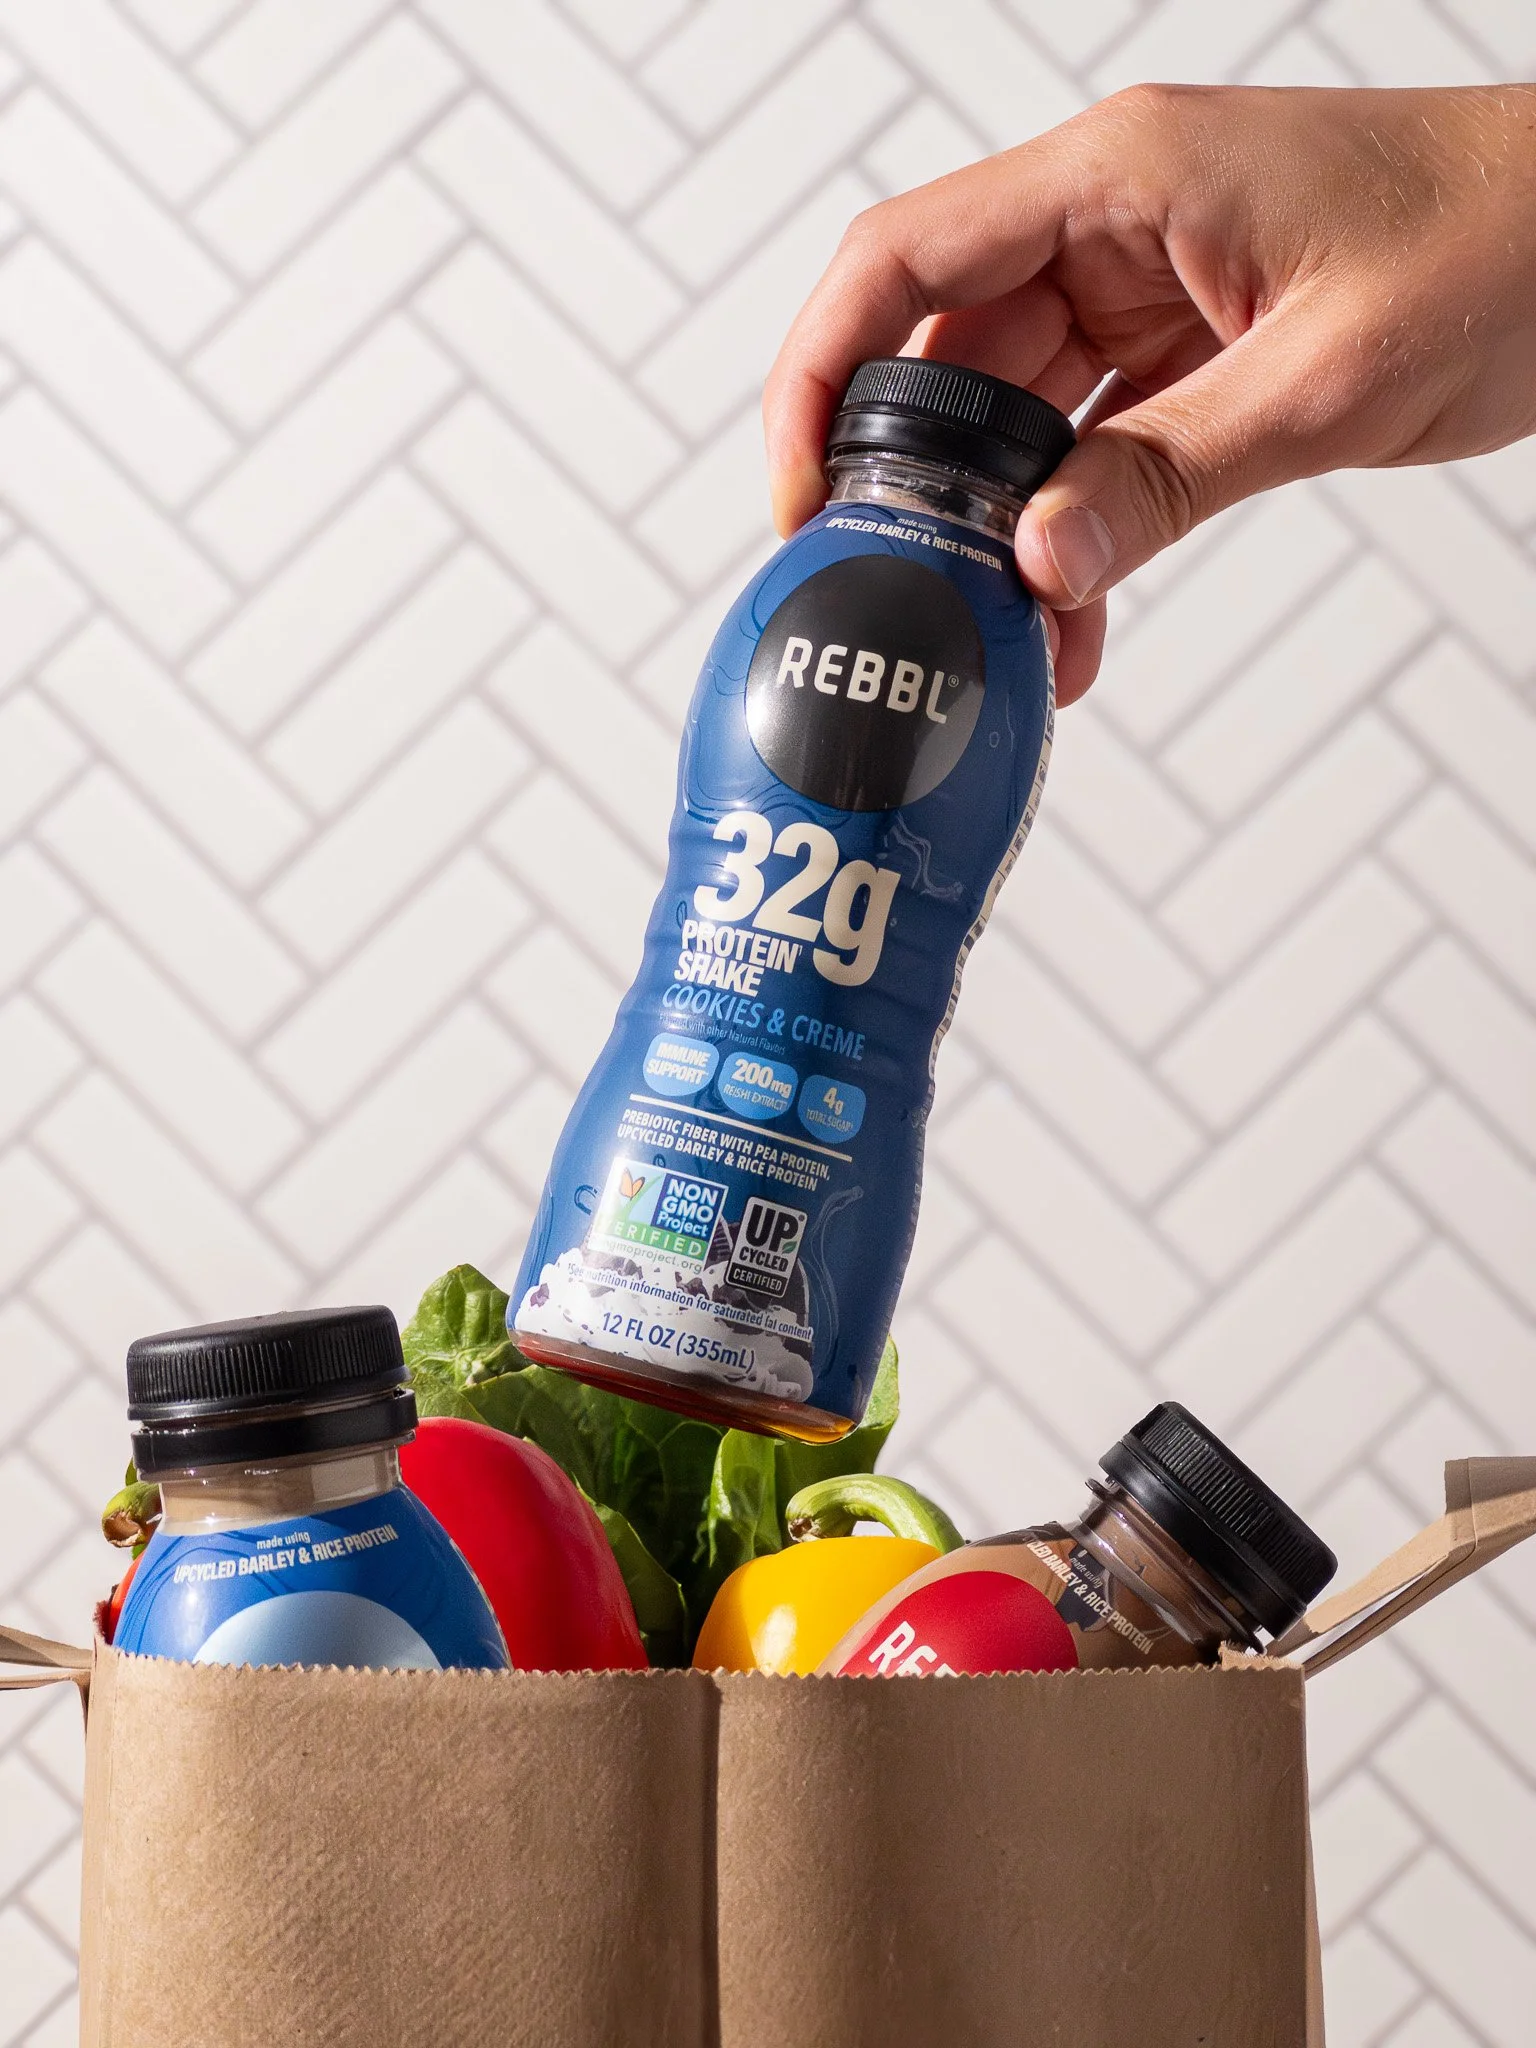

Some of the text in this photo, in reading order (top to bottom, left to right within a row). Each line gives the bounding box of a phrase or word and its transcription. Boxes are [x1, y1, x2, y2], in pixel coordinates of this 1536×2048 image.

[897, 518, 938, 534] made using
[825, 517, 1002, 571] UPCYCLED BARLEY & RICE PROTEIN
[693, 810, 901, 987] 32g
[673, 950, 765, 998] SHAKE
[662, 983, 765, 1029] COOKIES
[766, 1008, 786, 1036] &
[791, 1015, 866, 1061] CREME
[706, 1022, 728, 1040] other
[728, 1029, 759, 1047] Natural
[758, 1037, 786, 1056] Flavors
[646, 1058, 708, 1085] SUPPORT
[656, 1042, 711, 1068] IMMUNE
[723, 1083, 750, 1100] REISHI
[731, 1058, 792, 1098] 200mg
[823, 1087, 844, 1116] 4g
[622, 1109, 680, 1134] PREBIOTIC
[681, 1124, 718, 1145] FIBER
[719, 1133, 754, 1155] WITH
[755, 1144, 778, 1163] PEA
[617, 1124, 819, 1192] UPCYCLED BARLEY & RICE PROTEIN
[667, 1178, 719, 1207] NON
[656, 1212, 709, 1237] Project
[661, 1196, 715, 1224] GMO
[746, 1204, 800, 1252] UP
[739, 1246, 789, 1273] CYCLED
[733, 1269, 783, 1292] CERTIFIED
[629, 1279, 694, 1307] information
[696, 1294, 713, 1312] for
[713, 1303, 763, 1327] saturated
[778, 1322, 813, 1341] content
[601, 1312, 755, 1373] 12 FL OZ (355mL)
[173, 1523, 399, 1584] UPCYCLED BARLEY & RICE PROTEIN
[256, 1531, 311, 1549] made using
[1070, 1557, 1103, 1589] made using
[1042, 1554, 1082, 1587] BARLEY
[1073, 1583, 1088, 1597] &
[1082, 1591, 1113, 1618] RICE
[1106, 1610, 1154, 1655] PROTEIN
